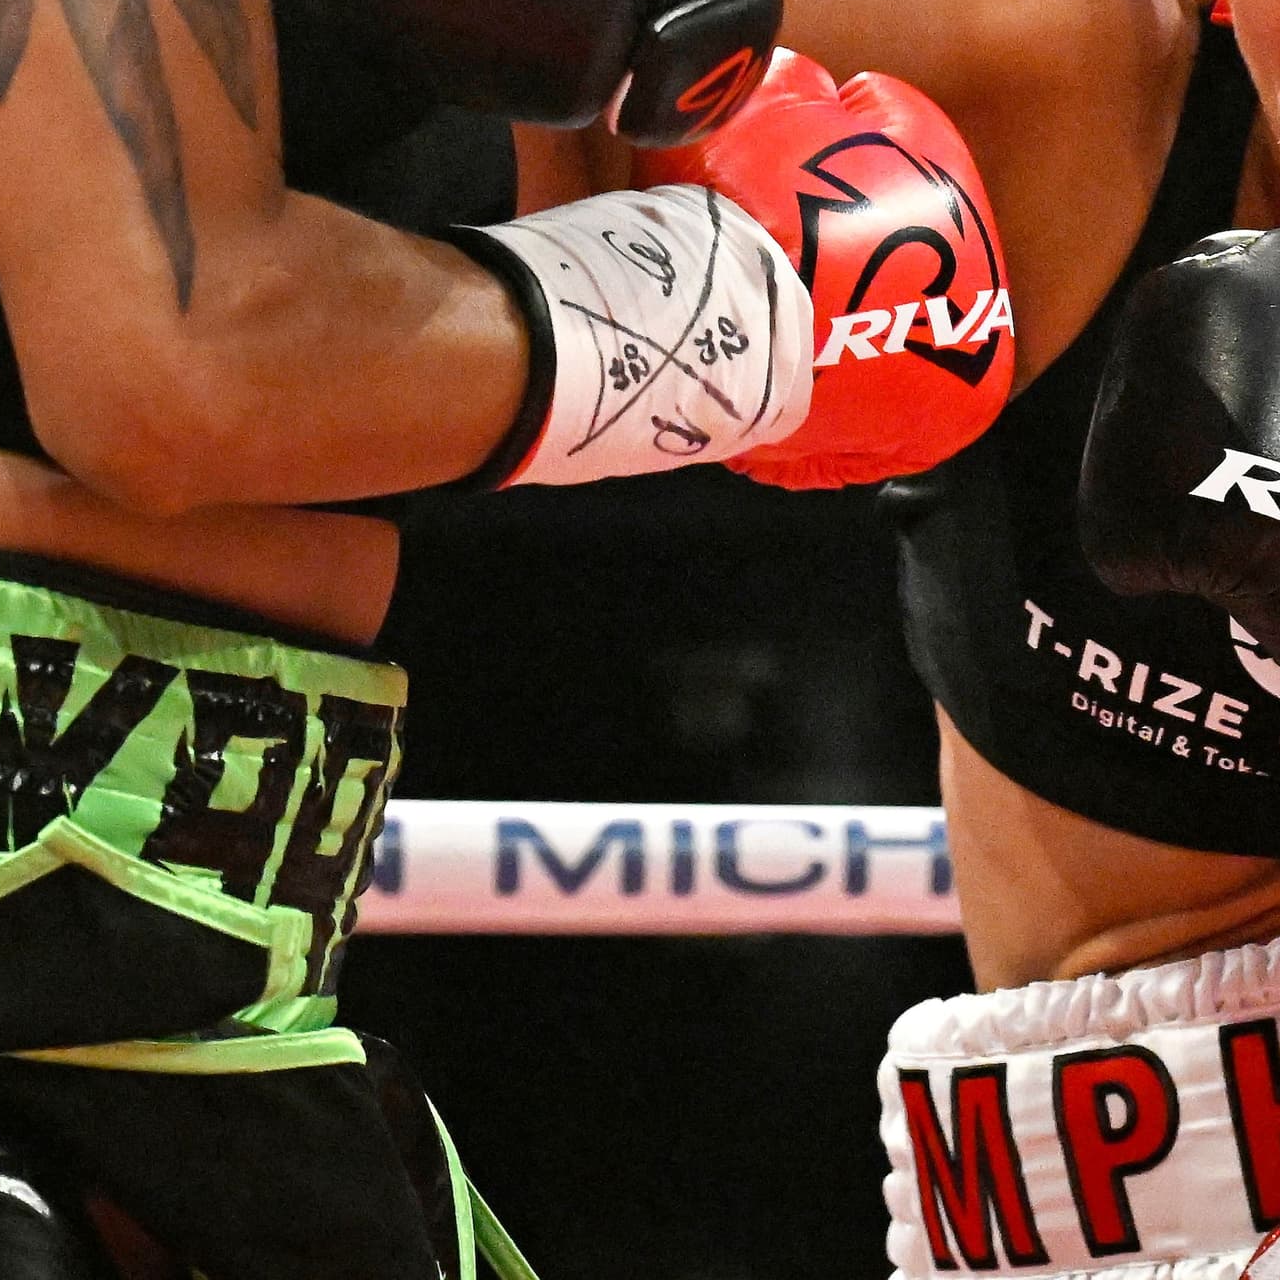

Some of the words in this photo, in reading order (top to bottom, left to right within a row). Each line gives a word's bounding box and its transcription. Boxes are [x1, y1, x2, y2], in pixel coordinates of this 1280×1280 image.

[1023, 598, 1250, 740] T-RIZE
[1070, 691, 1165, 746] Digital
[1171, 735, 1192, 759] &
